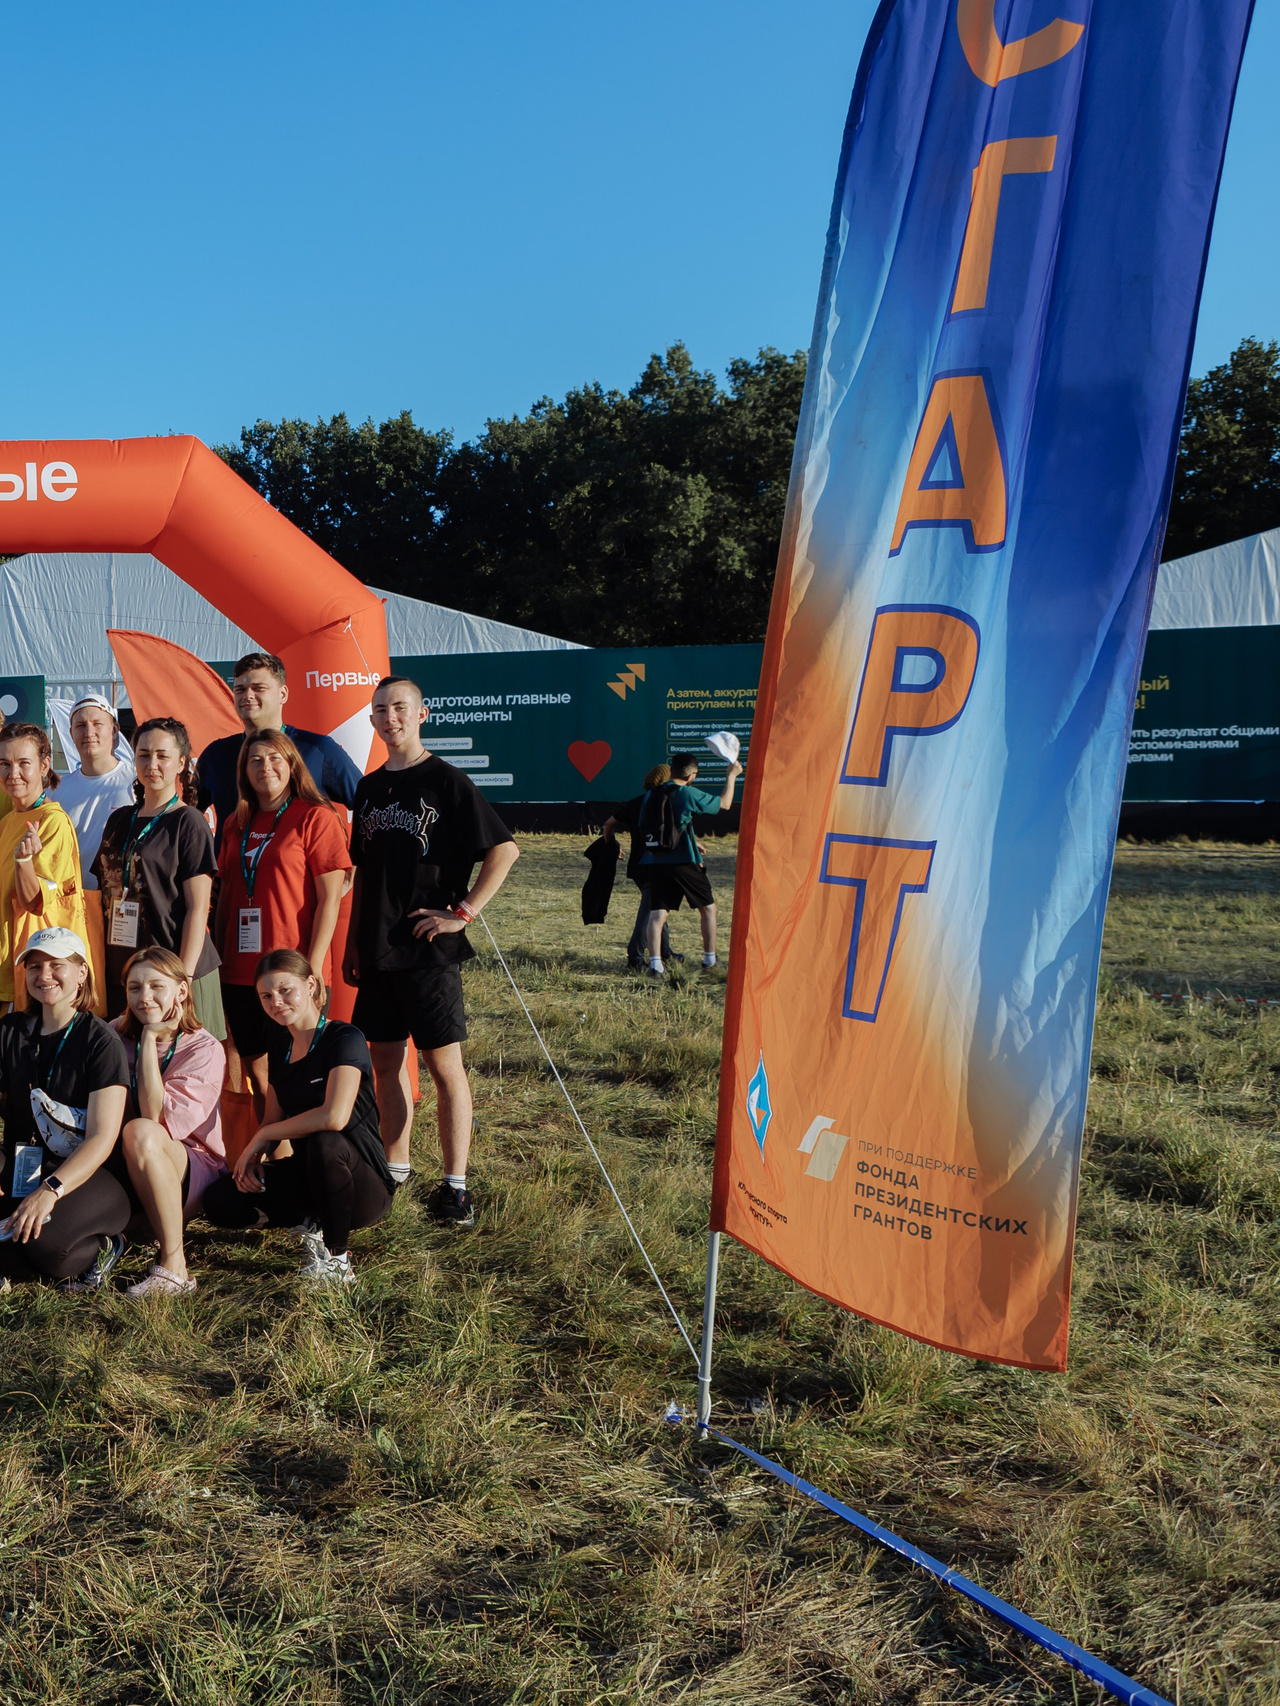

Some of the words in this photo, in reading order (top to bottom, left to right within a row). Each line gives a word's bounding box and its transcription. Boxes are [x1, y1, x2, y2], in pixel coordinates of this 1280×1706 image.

[305, 670, 381, 692] Первые
[506, 693, 571, 704] главные
[667, 688, 675, 697] А
[677, 689, 712, 699] затем,
[667, 701, 735, 710] приступаем
[1151, 728, 1217, 740] результат
[1220, 725, 1279, 738] общими
[858, 1140, 883, 1156] ПРИ
[886, 1147, 977, 1180] ПОДДЕРЖКЕ
[856, 1160, 920, 1190] ФОНДА
[854, 1181, 1028, 1235] ПРЕЗИДЕНТСКИХ
[853, 1203, 932, 1240] ГРАНТОВ
